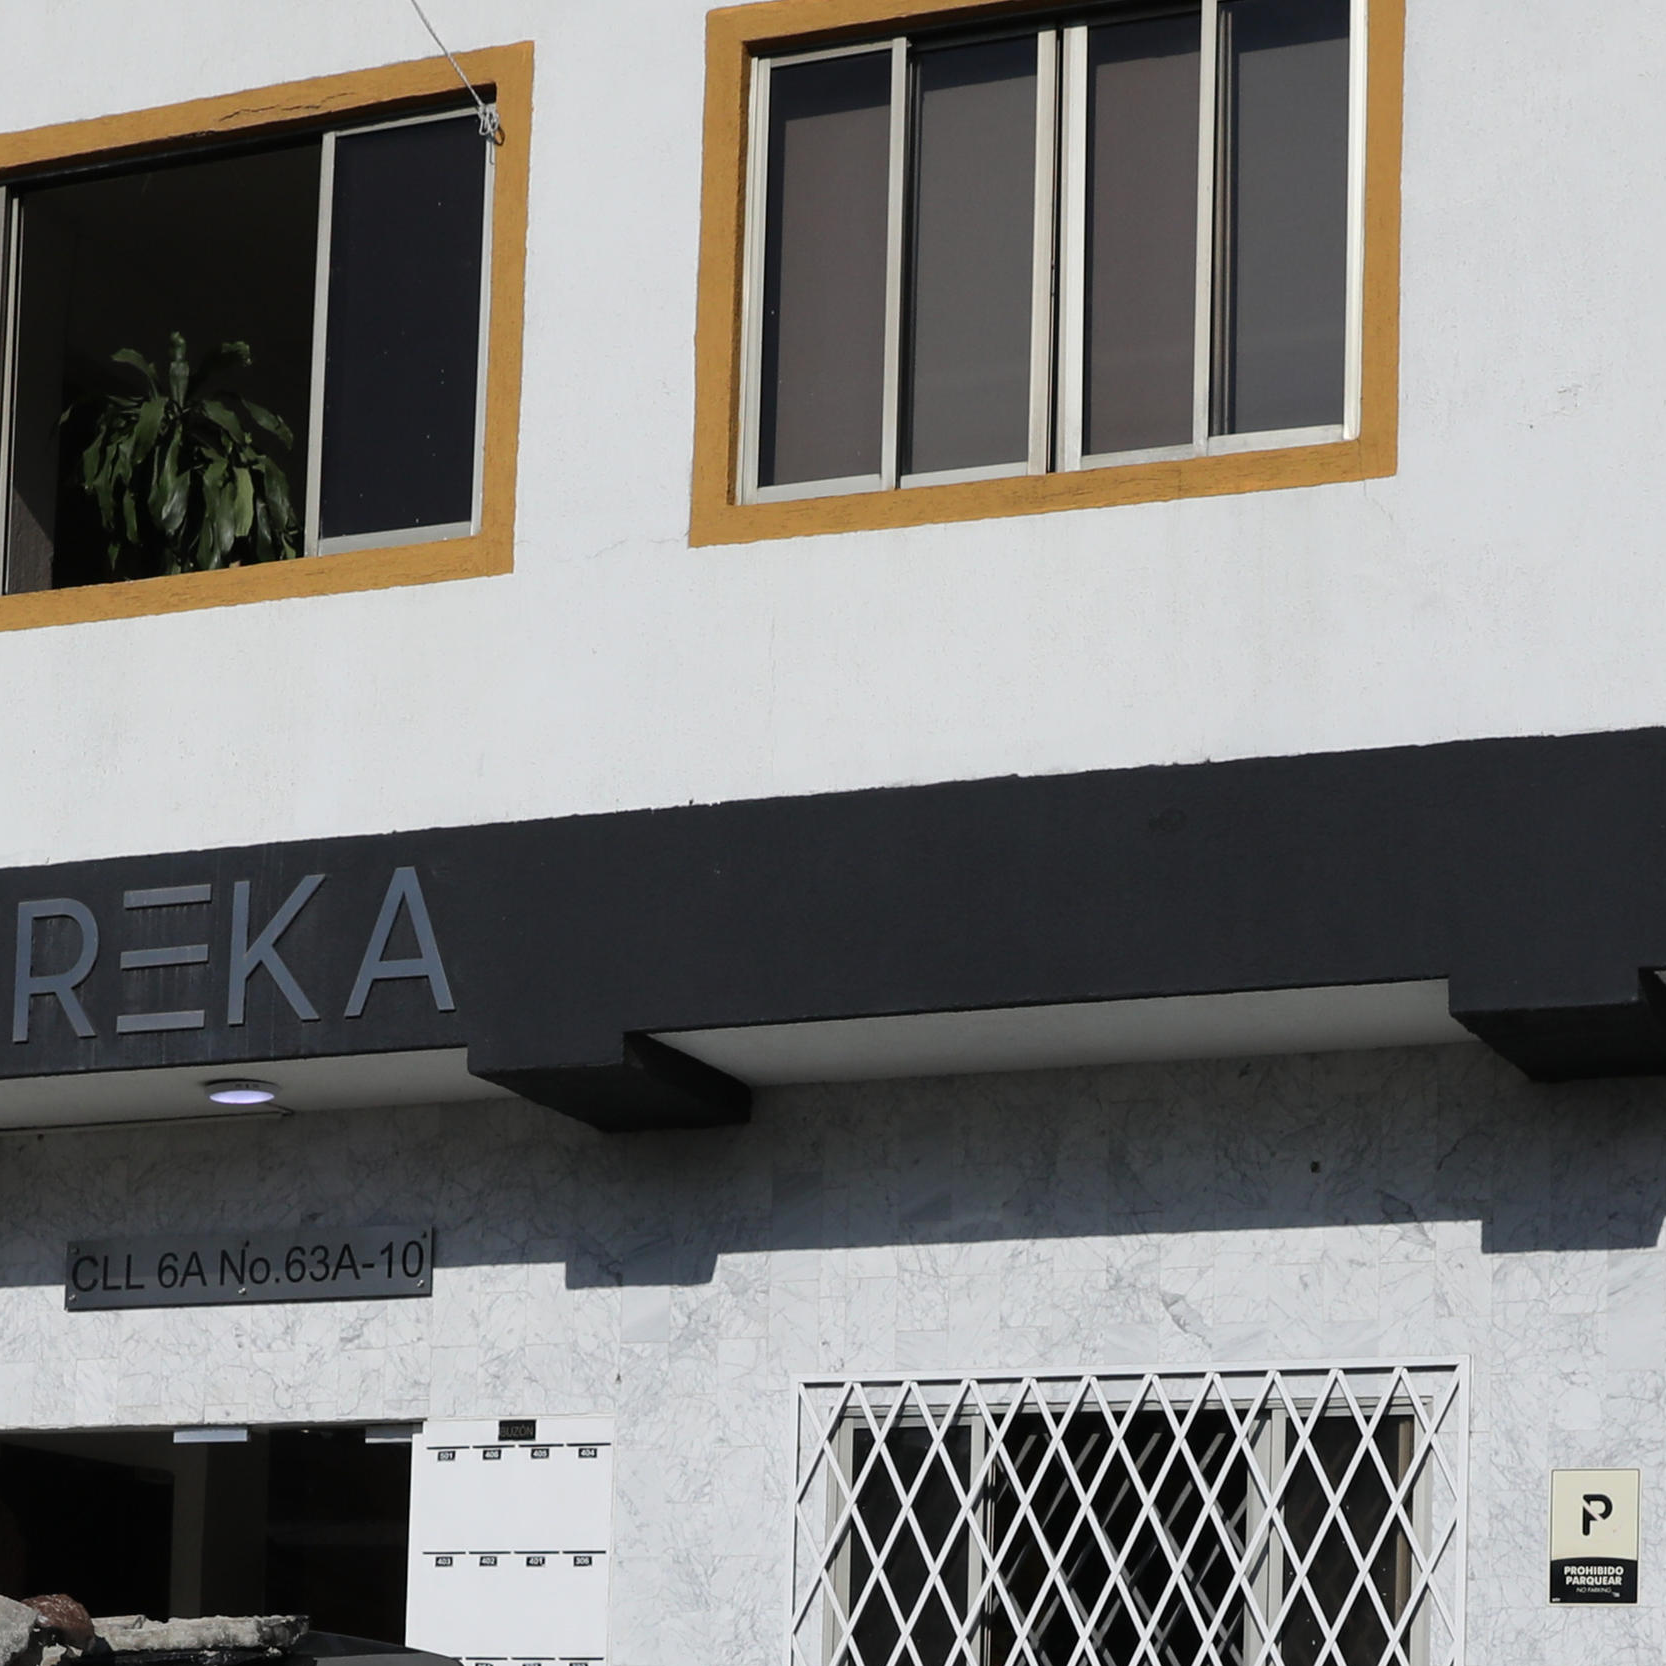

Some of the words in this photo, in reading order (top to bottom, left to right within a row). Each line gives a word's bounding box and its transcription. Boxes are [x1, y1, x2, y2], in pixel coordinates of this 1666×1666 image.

[71, 1255, 145, 1292] CLL
[157, 1251, 208, 1289] 6A
[500, 1424, 534, 1437] BUZÓN
[1564, 1566, 1624, 1575] PROHIBIDO
[1565, 1576, 1622, 1585] PARQUEAR
